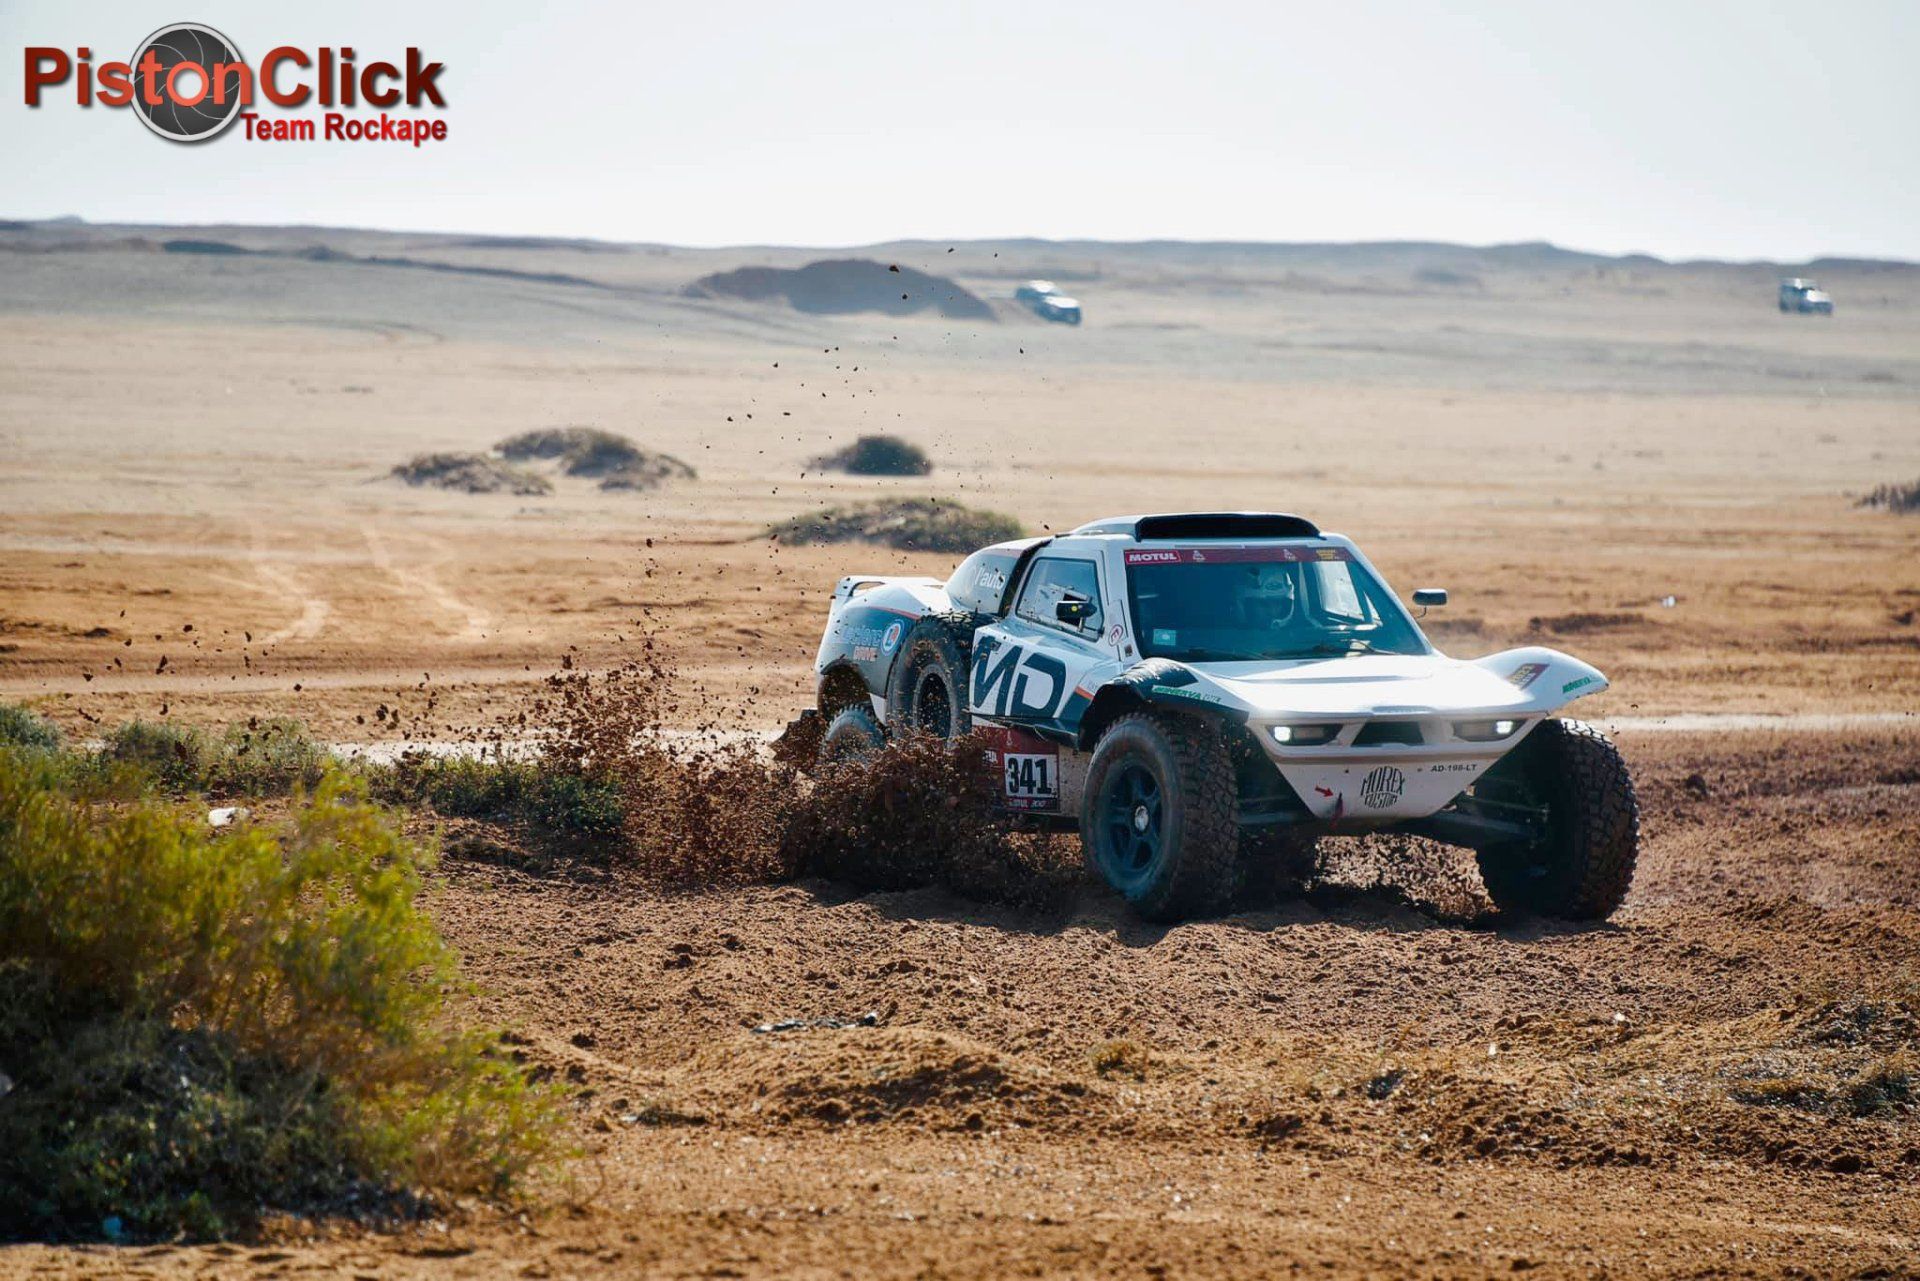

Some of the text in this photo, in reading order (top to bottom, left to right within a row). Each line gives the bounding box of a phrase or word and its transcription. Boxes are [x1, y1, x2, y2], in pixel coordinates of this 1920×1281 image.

[1129, 552, 1177, 562] MOTUL
[1008, 757, 1053, 795] 341
[1361, 766, 1405, 796] MOREX
